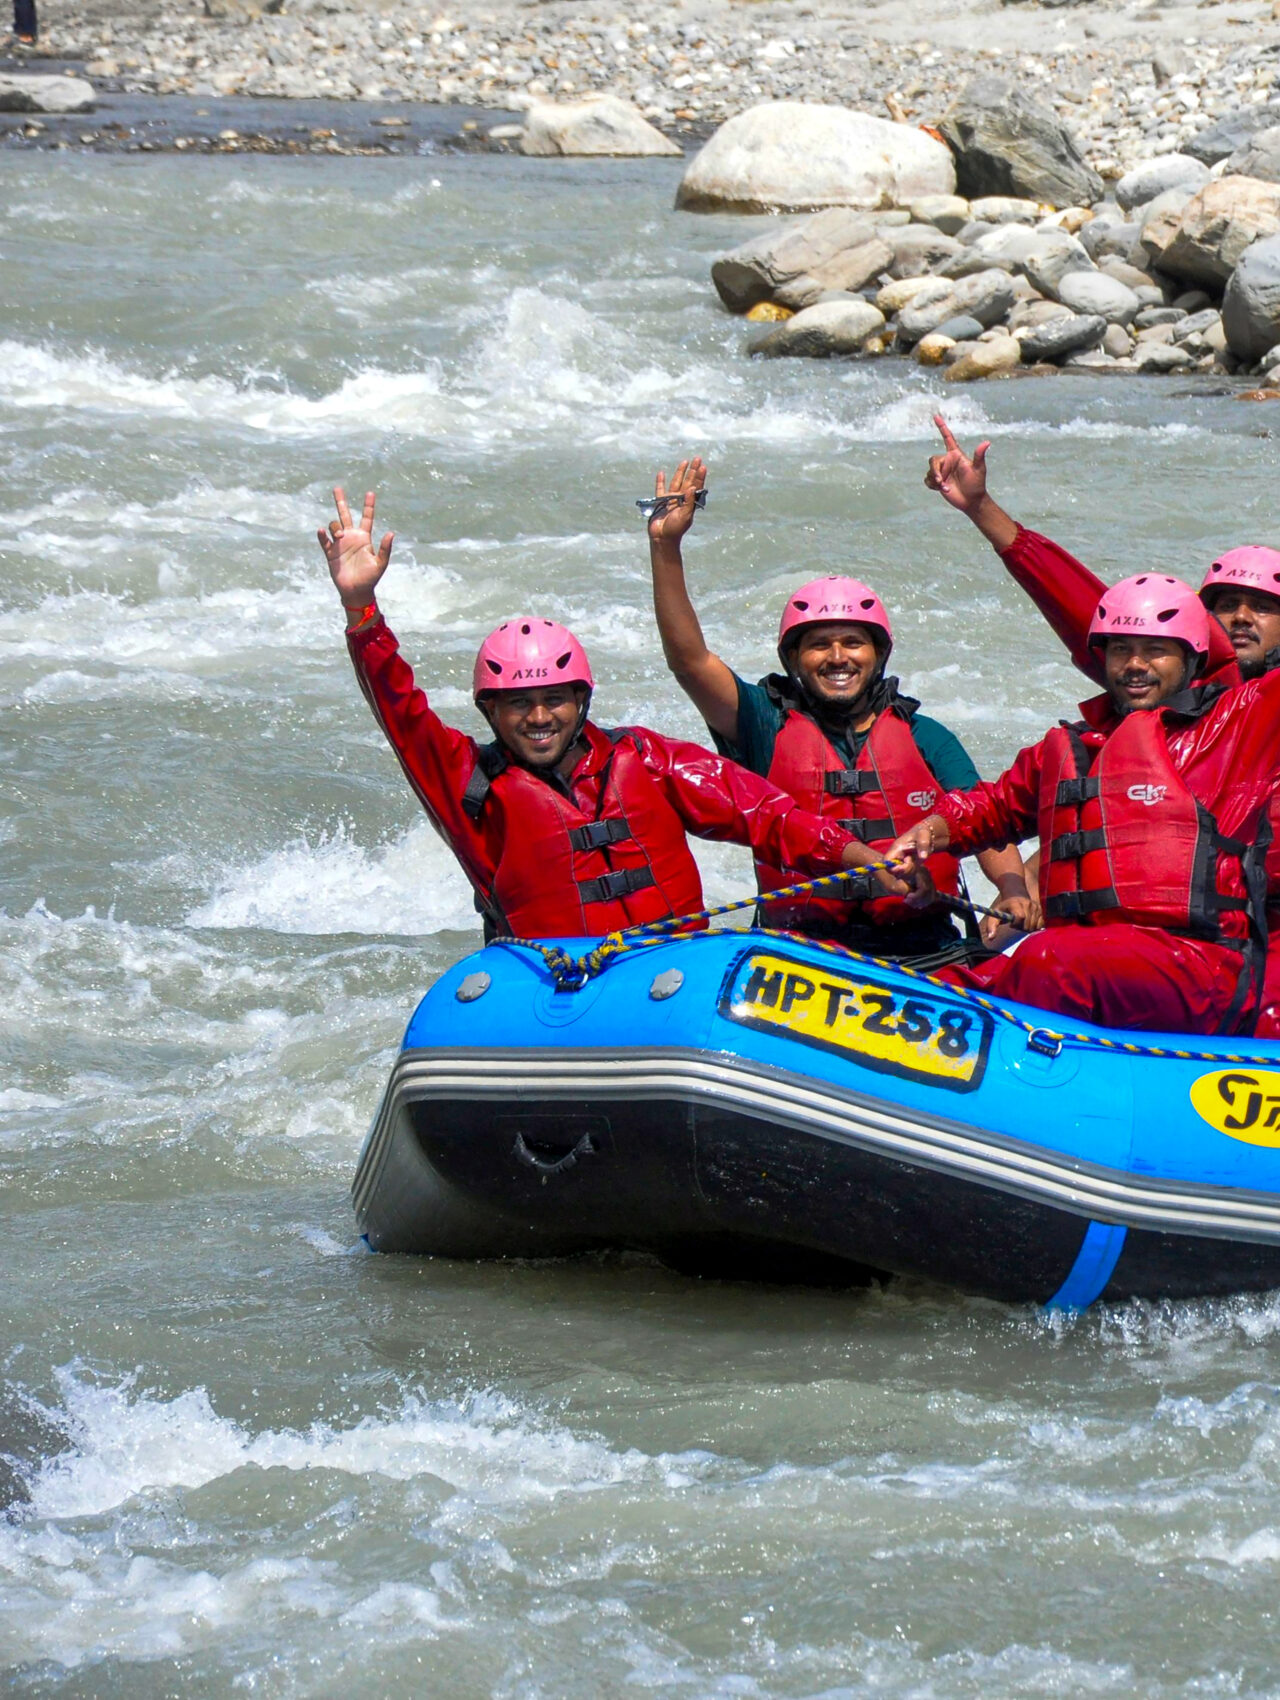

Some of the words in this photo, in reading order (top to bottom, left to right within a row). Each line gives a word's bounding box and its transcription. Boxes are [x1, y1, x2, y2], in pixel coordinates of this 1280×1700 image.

[1226, 568, 1263, 581] AXIS
[818, 603, 853, 613] AXIS
[1111, 615, 1146, 627] AXIS
[512, 668, 548, 680] AXIS
